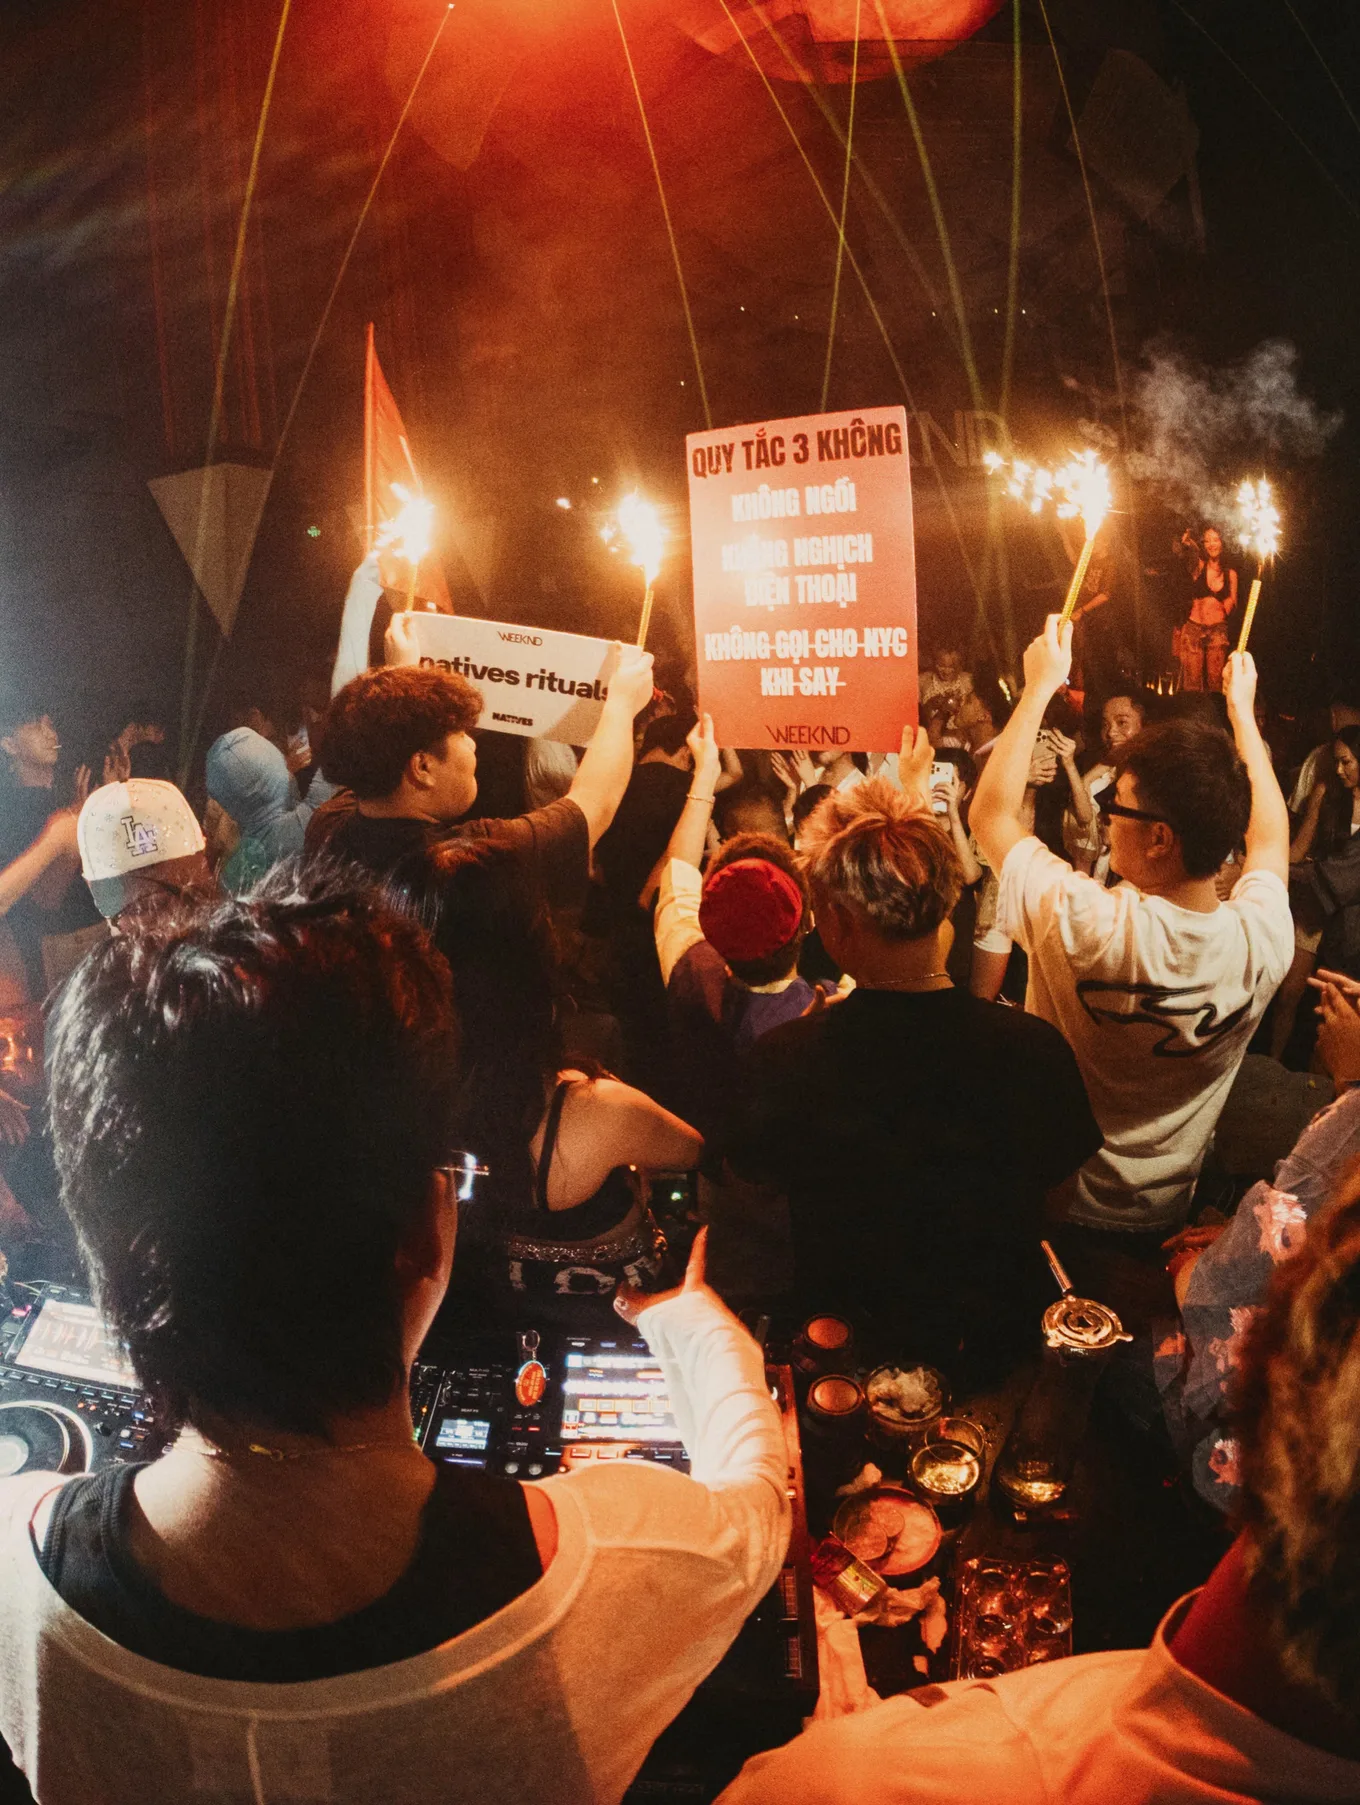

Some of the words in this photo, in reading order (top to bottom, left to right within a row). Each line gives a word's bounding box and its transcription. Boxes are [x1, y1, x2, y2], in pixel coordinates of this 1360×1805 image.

[692, 443, 735, 479] QUY
[741, 427, 786, 471] TẮC
[792, 433, 809, 464] 3
[817, 418, 903, 462] KHÔNG
[731, 483, 801, 522] KHÔNG
[793, 533, 873, 570] NGHỊCH
[795, 572, 857, 608] THOẠI
[497, 631, 543, 647] WEEKND
[704, 625, 770, 661] KHÔNG
[775, 629, 809, 665] GỌI
[815, 628, 857, 658] CHO
[863, 627, 908, 658] NYC
[760, 667, 793, 696] KHI
[799, 666, 840, 696] SAY
[764, 725, 851, 746] WEEKND
[121, 815, 158, 857] LA
